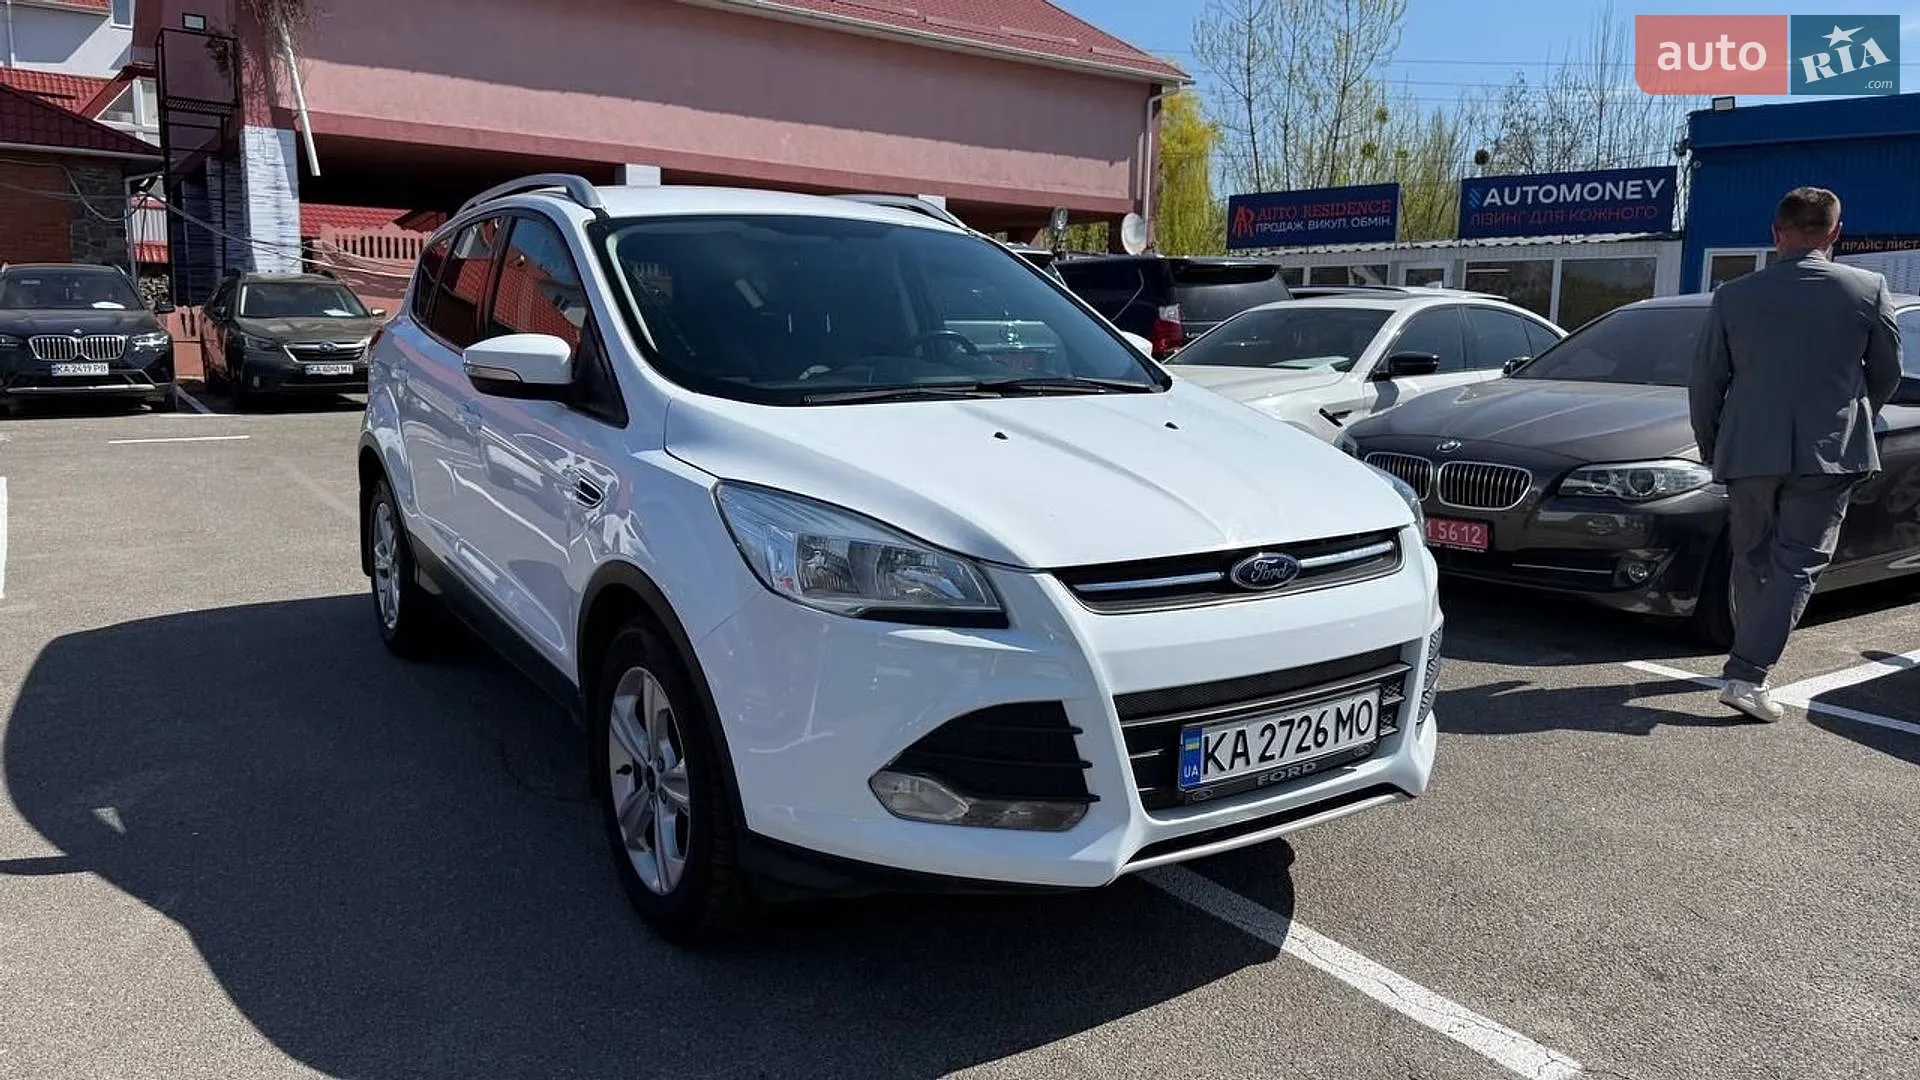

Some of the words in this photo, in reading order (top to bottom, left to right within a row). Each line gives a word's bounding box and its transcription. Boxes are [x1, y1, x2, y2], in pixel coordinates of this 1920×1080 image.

[1483, 178, 1666, 208] AUTOMONEY
[1256, 204, 1298, 221] AUTO
[1303, 199, 1393, 219] RESIDENCE
[1569, 205, 1659, 223] КОЖНОГО
[1841, 239, 1884, 252] ПРАЙС
[1886, 239, 1920, 250] ЛИСТ
[1438, 521, 1482, 545] 5612
[1251, 559, 1289, 582] Ford
[1203, 729, 1251, 775] KA
[1258, 709, 1330, 764] 2726
[1334, 699, 1373, 745] MO
[1184, 766, 1199, 779] UA
[1256, 762, 1317, 787] FORD
